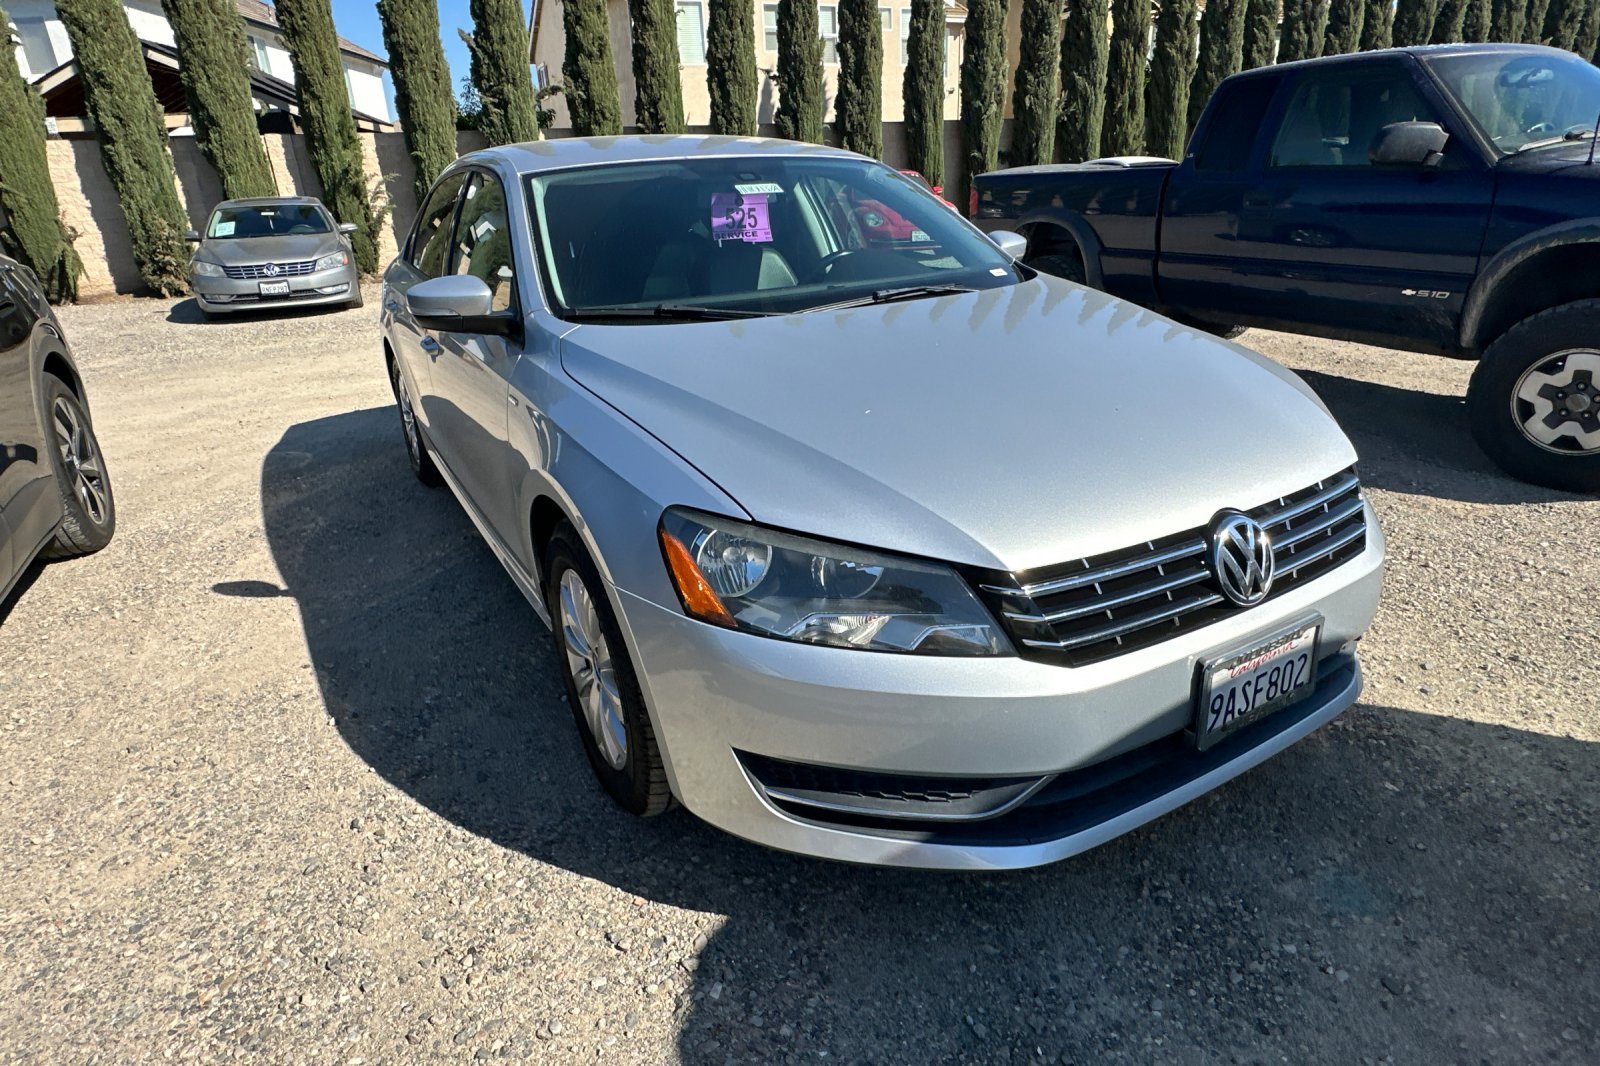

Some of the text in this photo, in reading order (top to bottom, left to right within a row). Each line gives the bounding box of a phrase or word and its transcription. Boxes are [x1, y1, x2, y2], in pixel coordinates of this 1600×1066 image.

[726, 207, 758, 230] 525
[1416, 289, 1451, 299] S10
[1217, 515, 1274, 606] VW
[1230, 640, 1299, 679] California
[1206, 653, 1308, 735] 9ASF802
